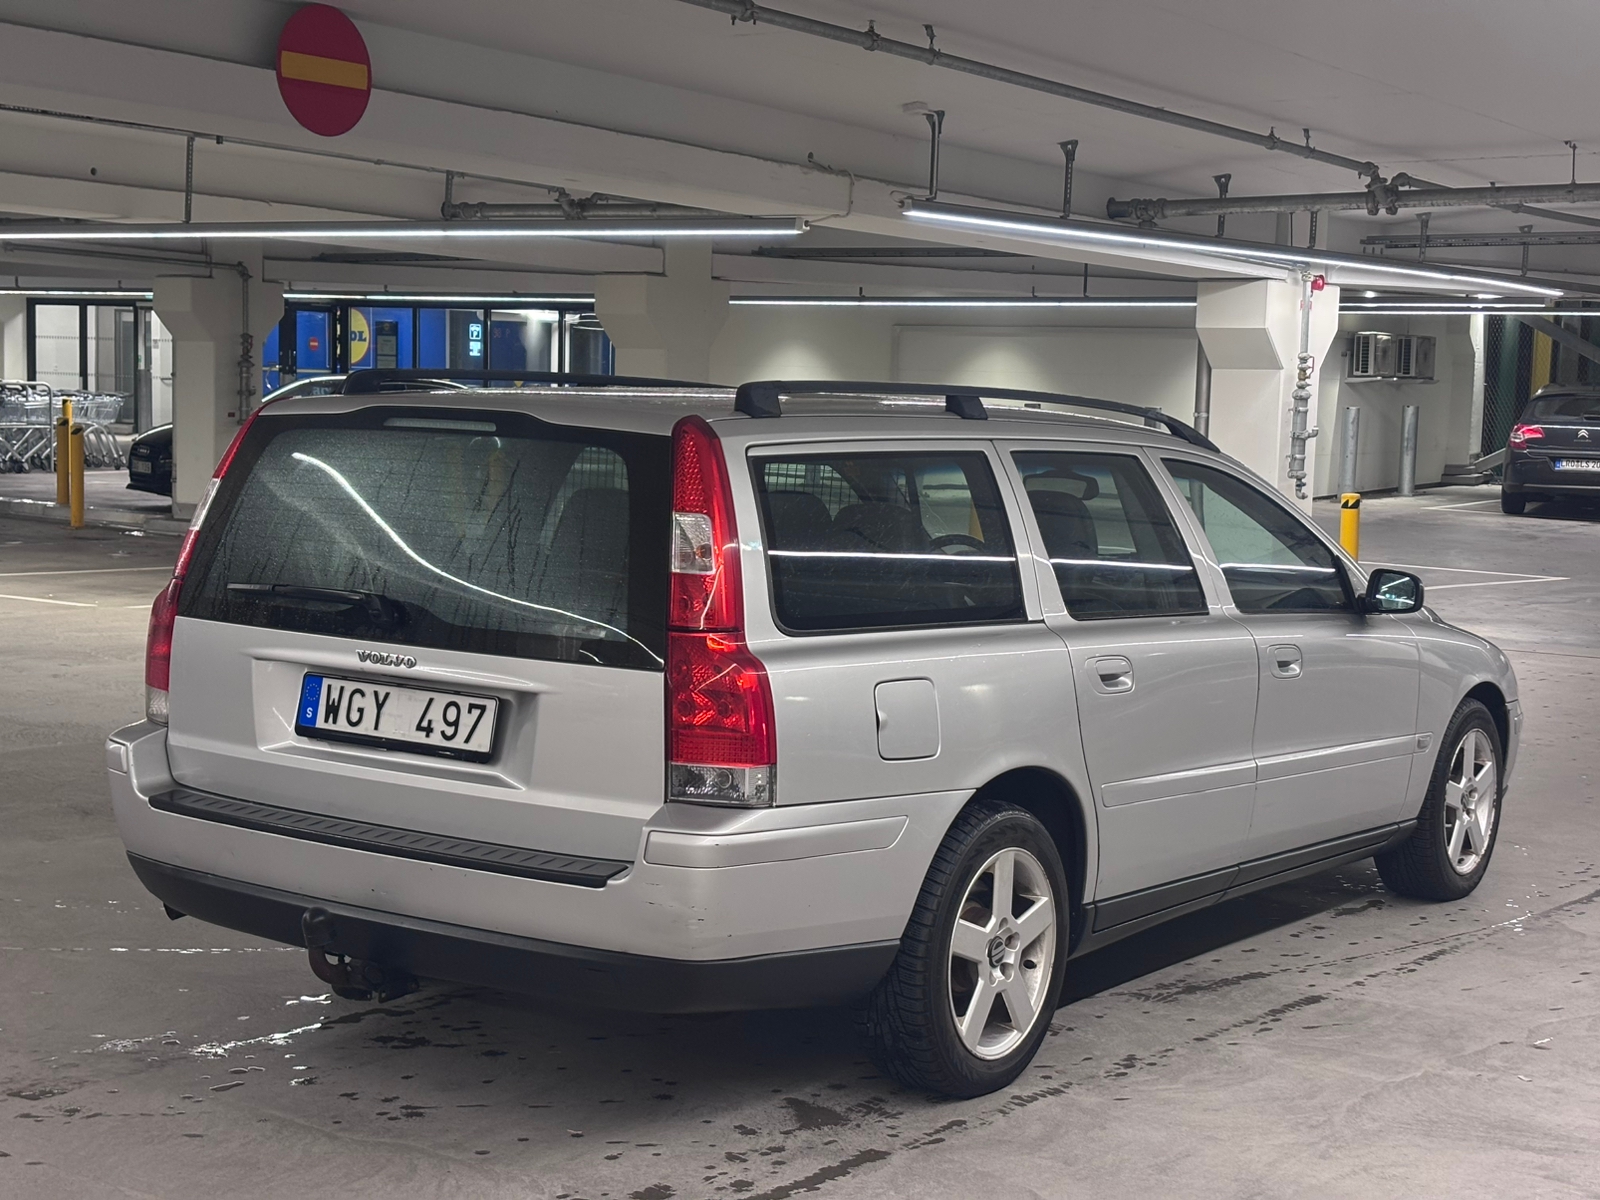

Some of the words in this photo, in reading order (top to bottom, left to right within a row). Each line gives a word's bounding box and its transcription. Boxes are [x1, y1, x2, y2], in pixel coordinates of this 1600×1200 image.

[350, 330, 367, 342] DL
[355, 649, 417, 669] VOLVO
[305, 706, 313, 719] S
[323, 683, 391, 731] WGY
[415, 697, 487, 745] 497
